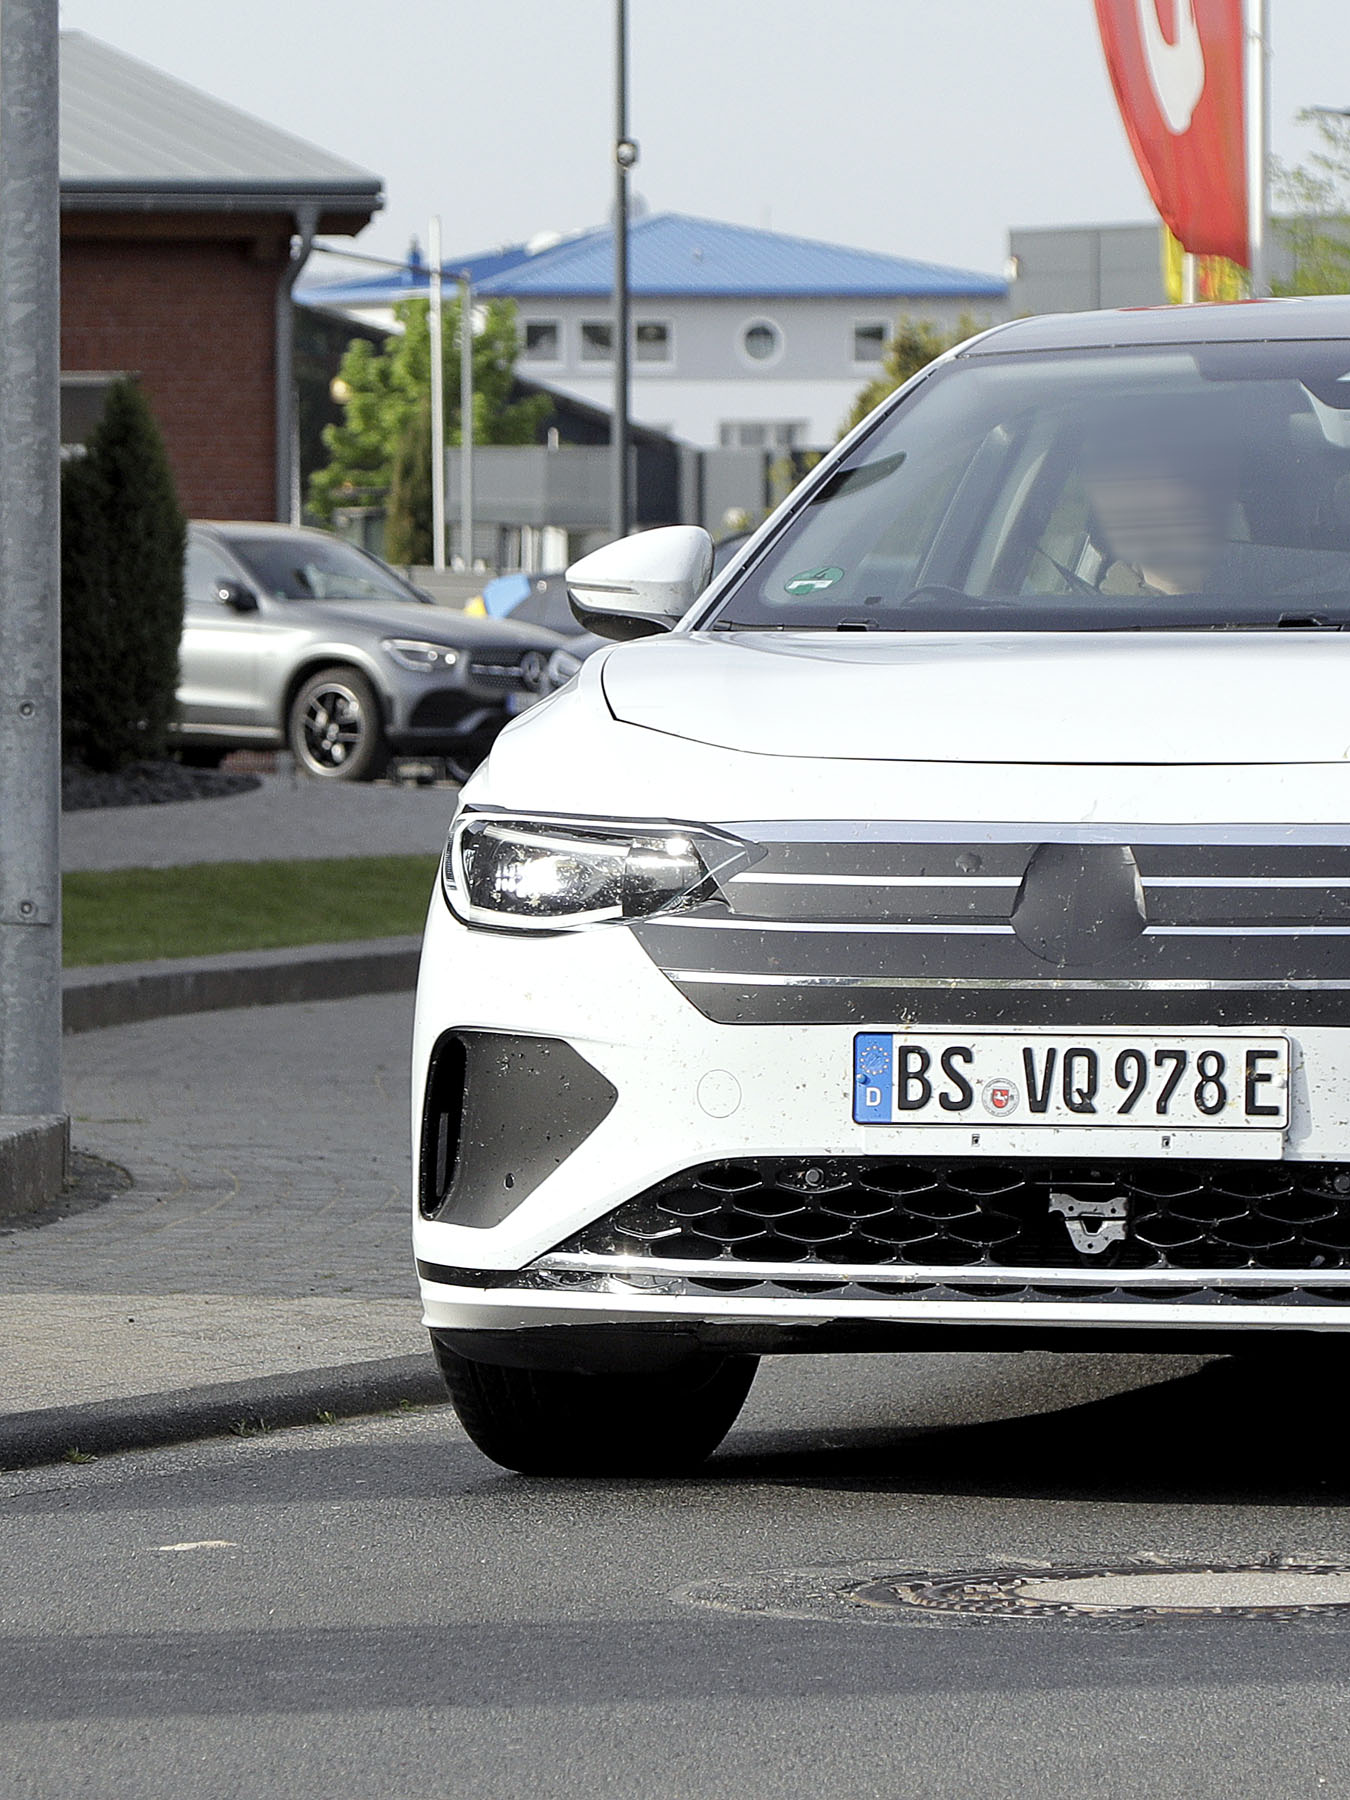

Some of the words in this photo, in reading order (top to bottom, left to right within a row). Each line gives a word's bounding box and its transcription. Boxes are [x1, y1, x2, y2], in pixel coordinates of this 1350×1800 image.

[866, 1086, 882, 1107] D
[898, 1045, 973, 1112] BS
[1022, 1047, 1098, 1114] VQ
